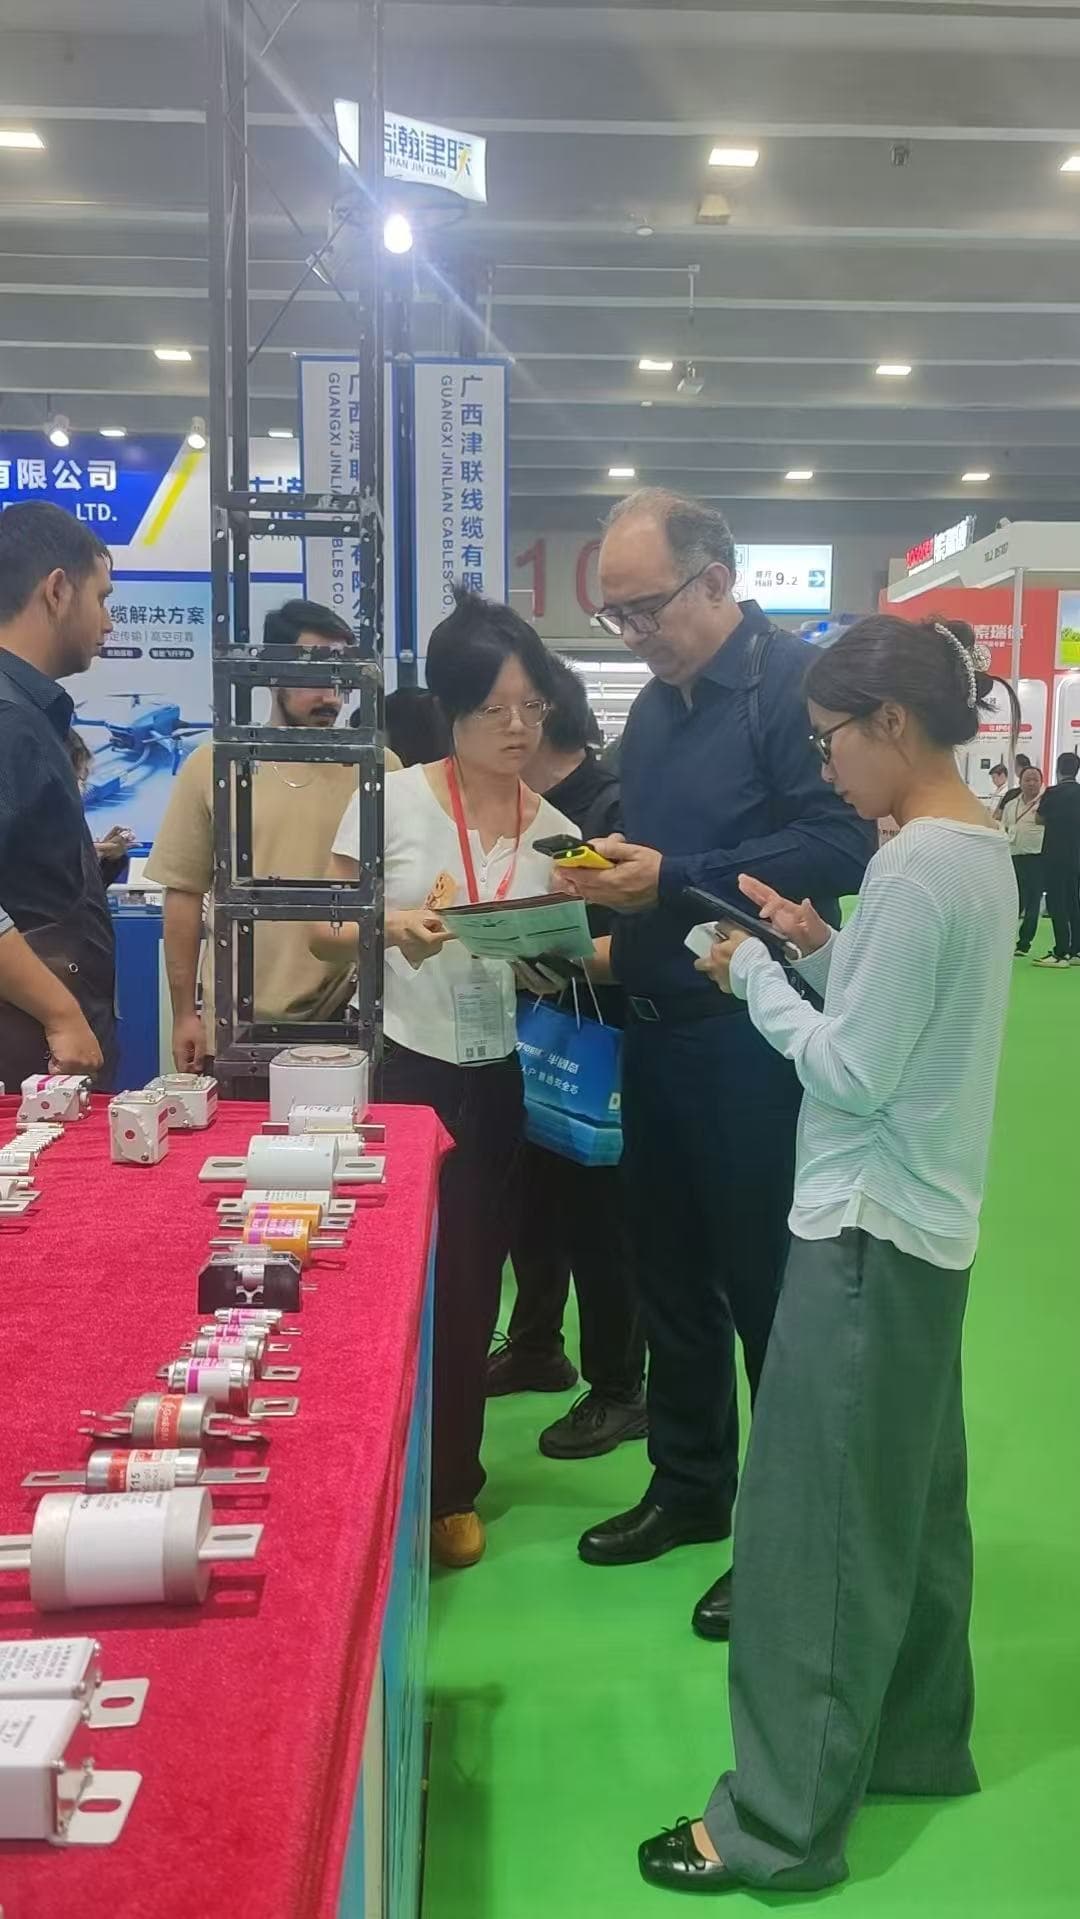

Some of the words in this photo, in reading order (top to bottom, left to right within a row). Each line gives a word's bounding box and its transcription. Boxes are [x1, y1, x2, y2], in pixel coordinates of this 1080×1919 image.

[328, 371, 342, 447] GUANGXI
[440, 374, 454, 448] GUANGXI
[75, 502, 118, 522] LTD.
[441, 451, 454, 512] JINLIAN
[460, 374, 485, 594] 广西津联线缆有限
[441, 517, 454, 579] CABLES
[110, 604, 206, 625] 缆解决方案
